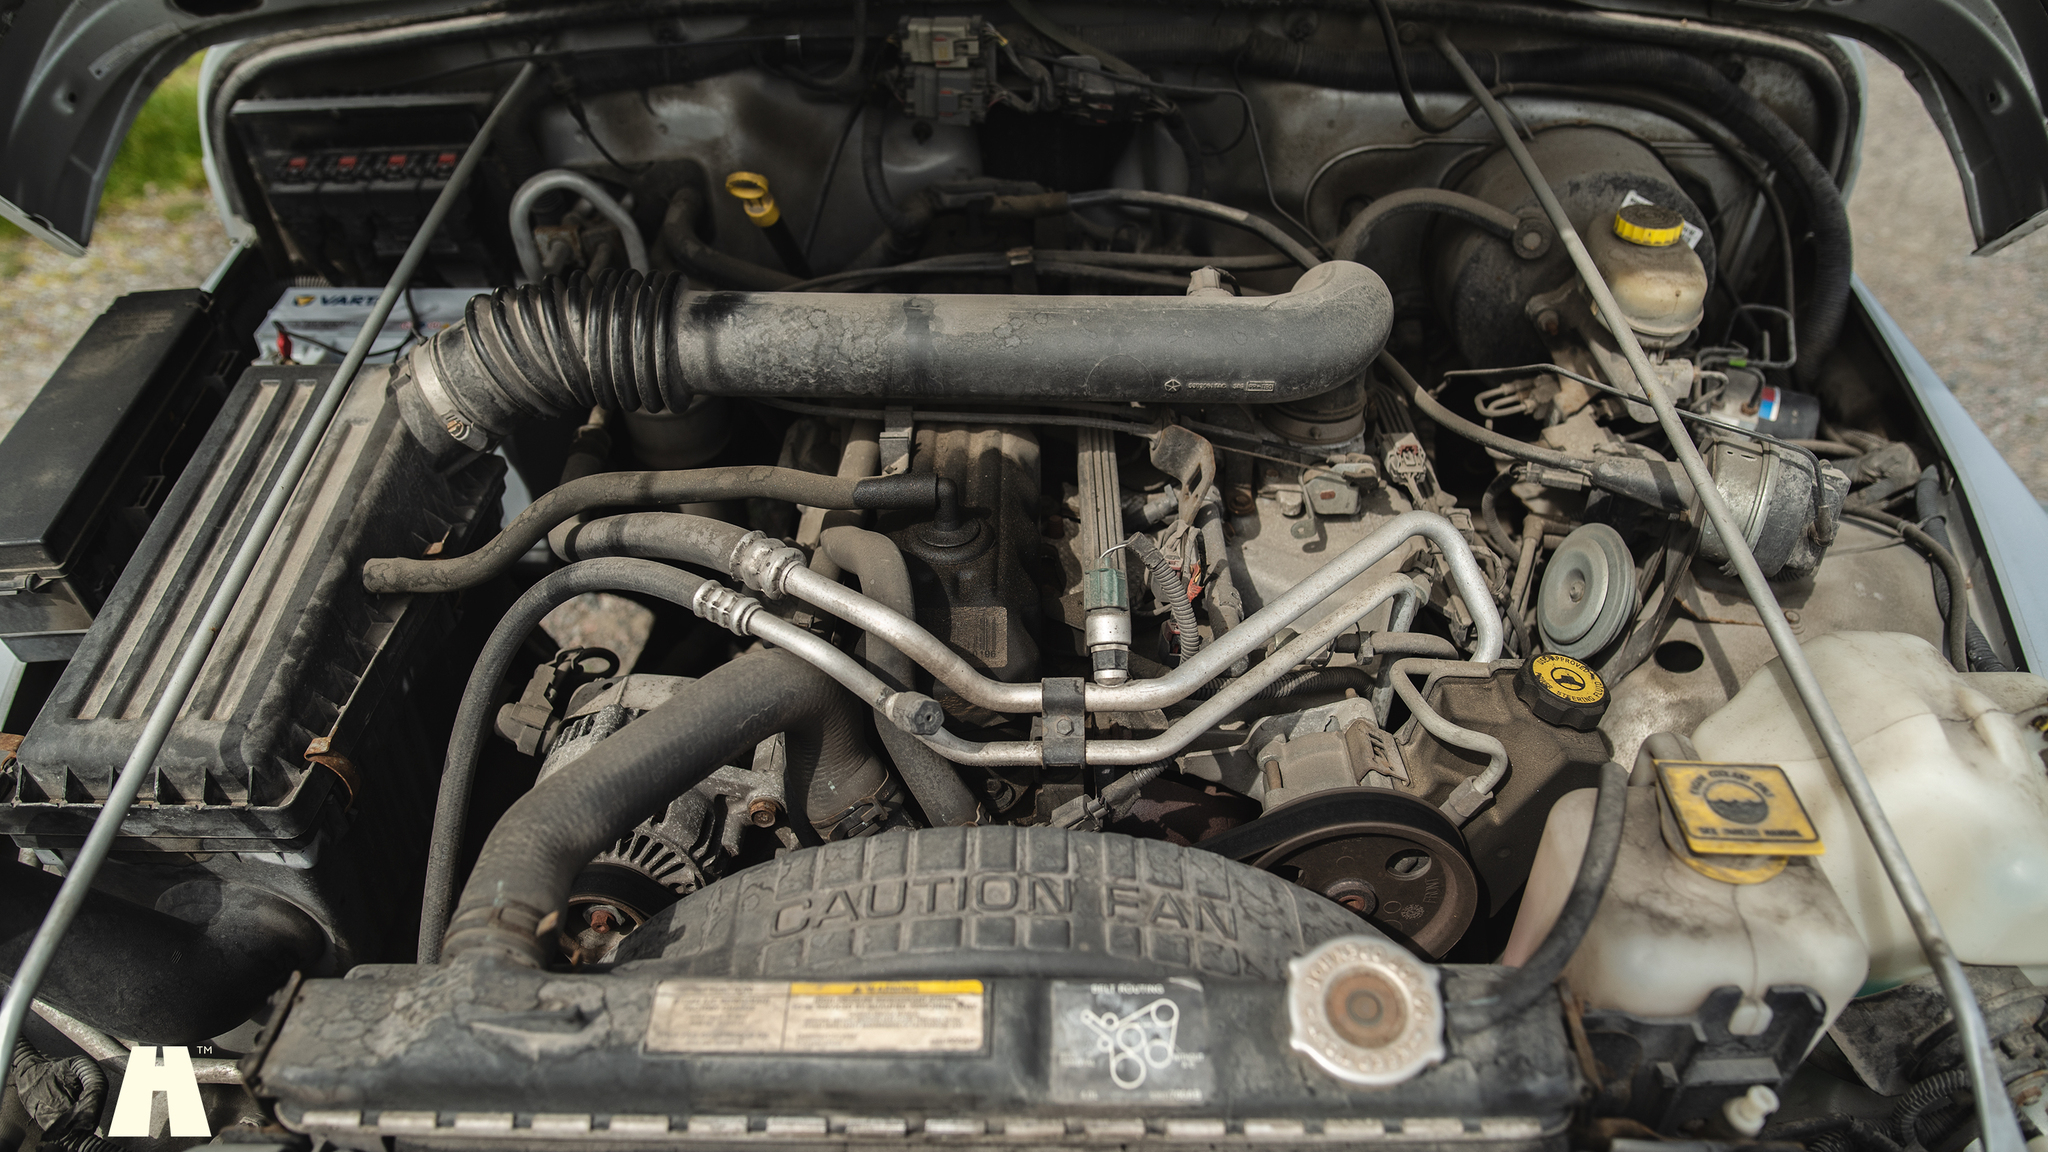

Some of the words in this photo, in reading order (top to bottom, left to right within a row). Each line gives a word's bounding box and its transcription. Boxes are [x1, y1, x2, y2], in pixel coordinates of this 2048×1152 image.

[319, 294, 380, 307] VART
[1593, 681, 1605, 698] FLUID
[1708, 770, 1751, 782] COOLANT
[1423, 877, 1440, 904] FRONT
[770, 873, 1073, 938] CAUTION
[1105, 878, 1238, 941] FAN
[1090, 983, 1116, 995] BELT
[1117, 983, 1166, 995] ROUTING
